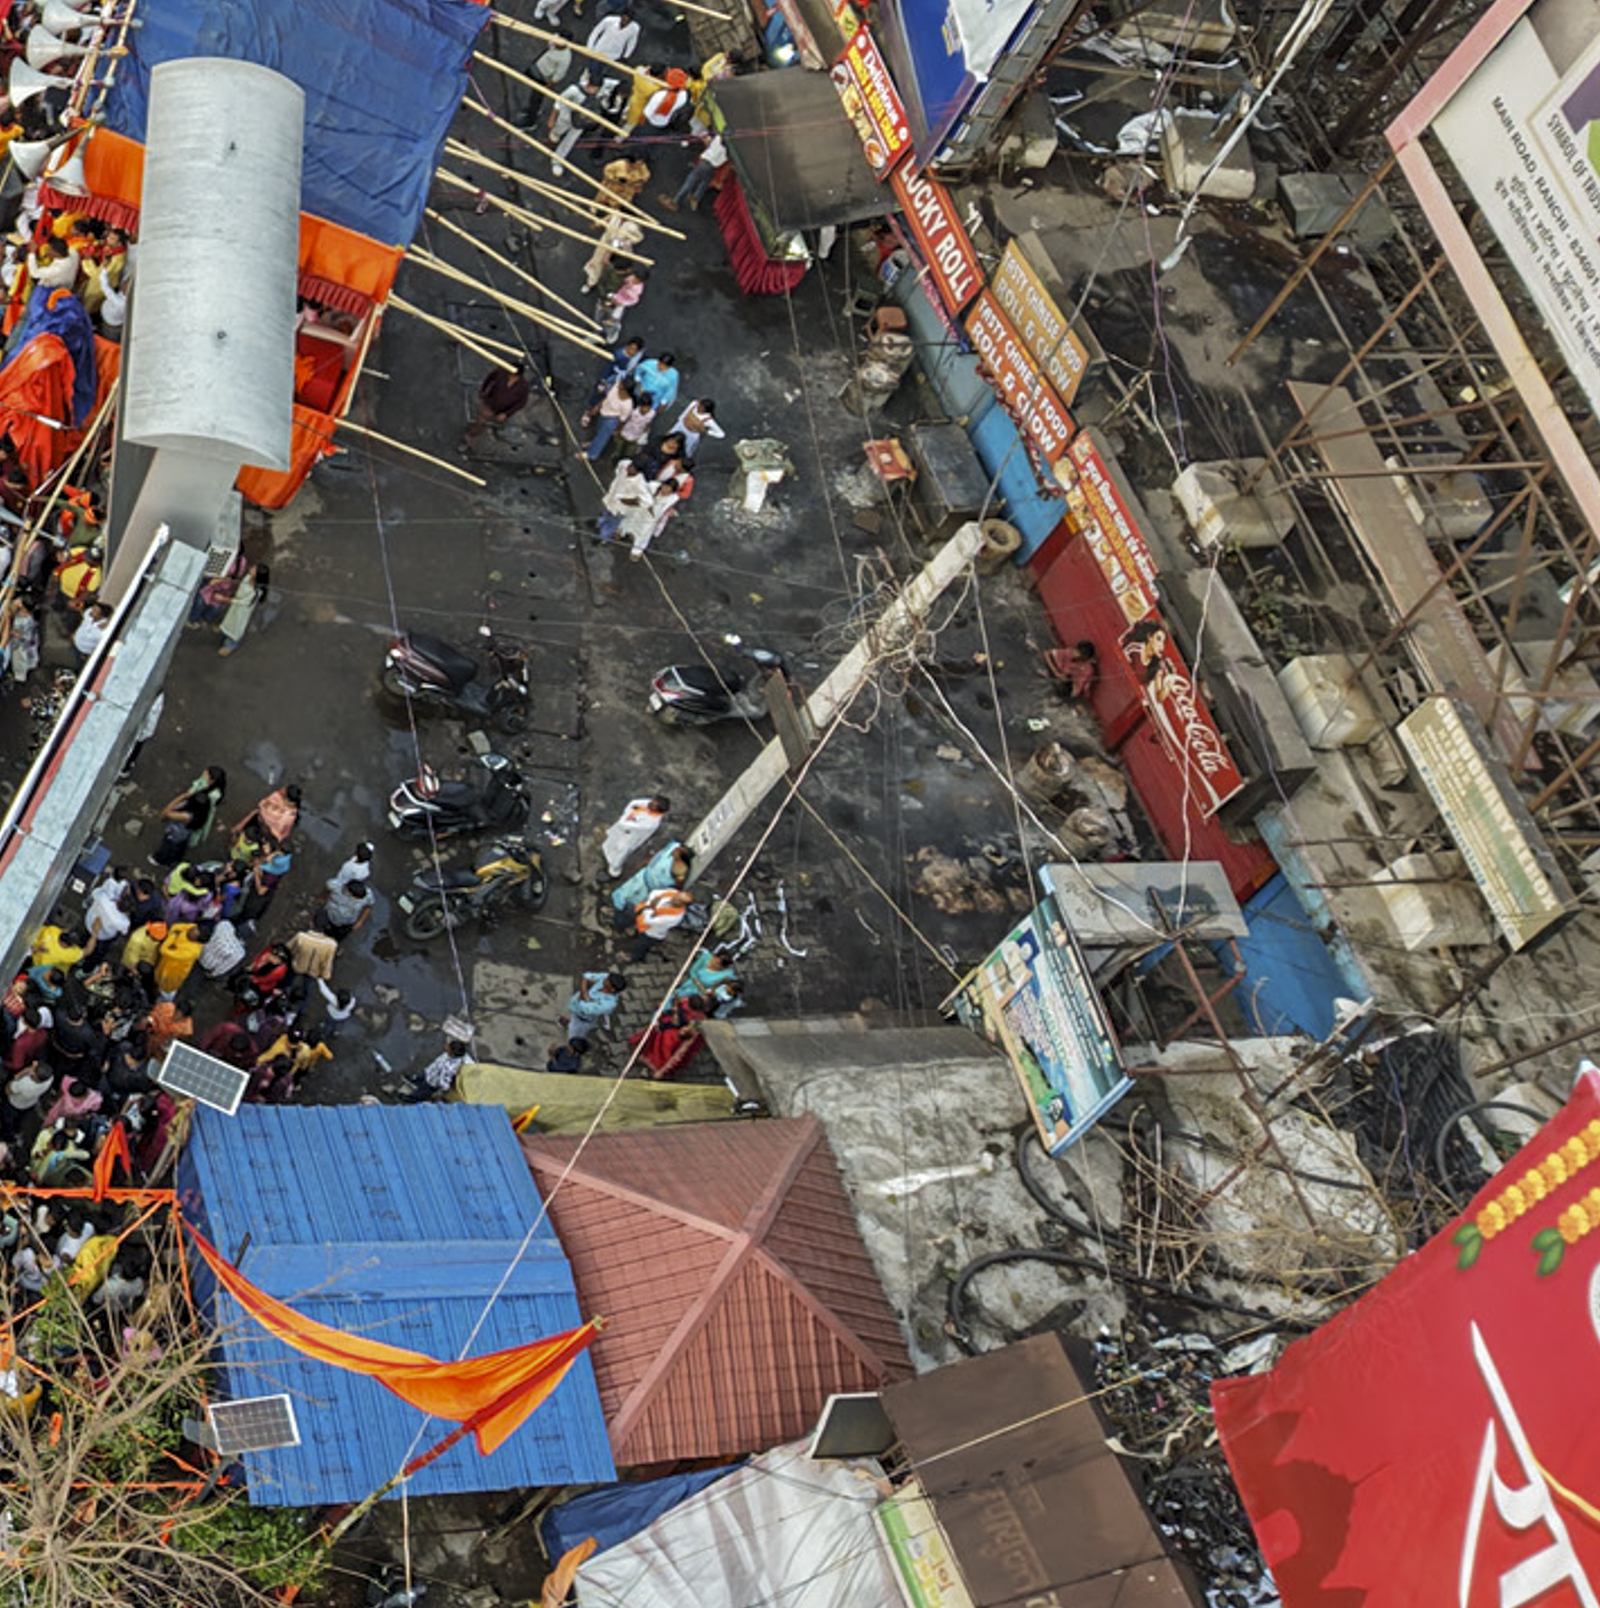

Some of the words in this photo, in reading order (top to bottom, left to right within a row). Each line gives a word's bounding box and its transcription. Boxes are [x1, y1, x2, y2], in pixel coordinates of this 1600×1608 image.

[863, 49, 900, 126] Delicious
[1491, 96, 1517, 135] MAIN
[1510, 131, 1538, 179] ROAD,
[1534, 176, 1570, 232] RANCHI
[1545, 112, 1579, 163] SYMBOL
[899, 157, 948, 242] LUCKY
[933, 232, 975, 303] ROLL
[994, 275, 1030, 327] ROLL
[1001, 249, 1033, 291] TASTY
[968, 318, 1009, 379] ROLL
[976, 295, 1007, 344] TASTY
[1038, 396, 1068, 442] FOOD
[1162, 672, 1225, 776] Coca-Cola
